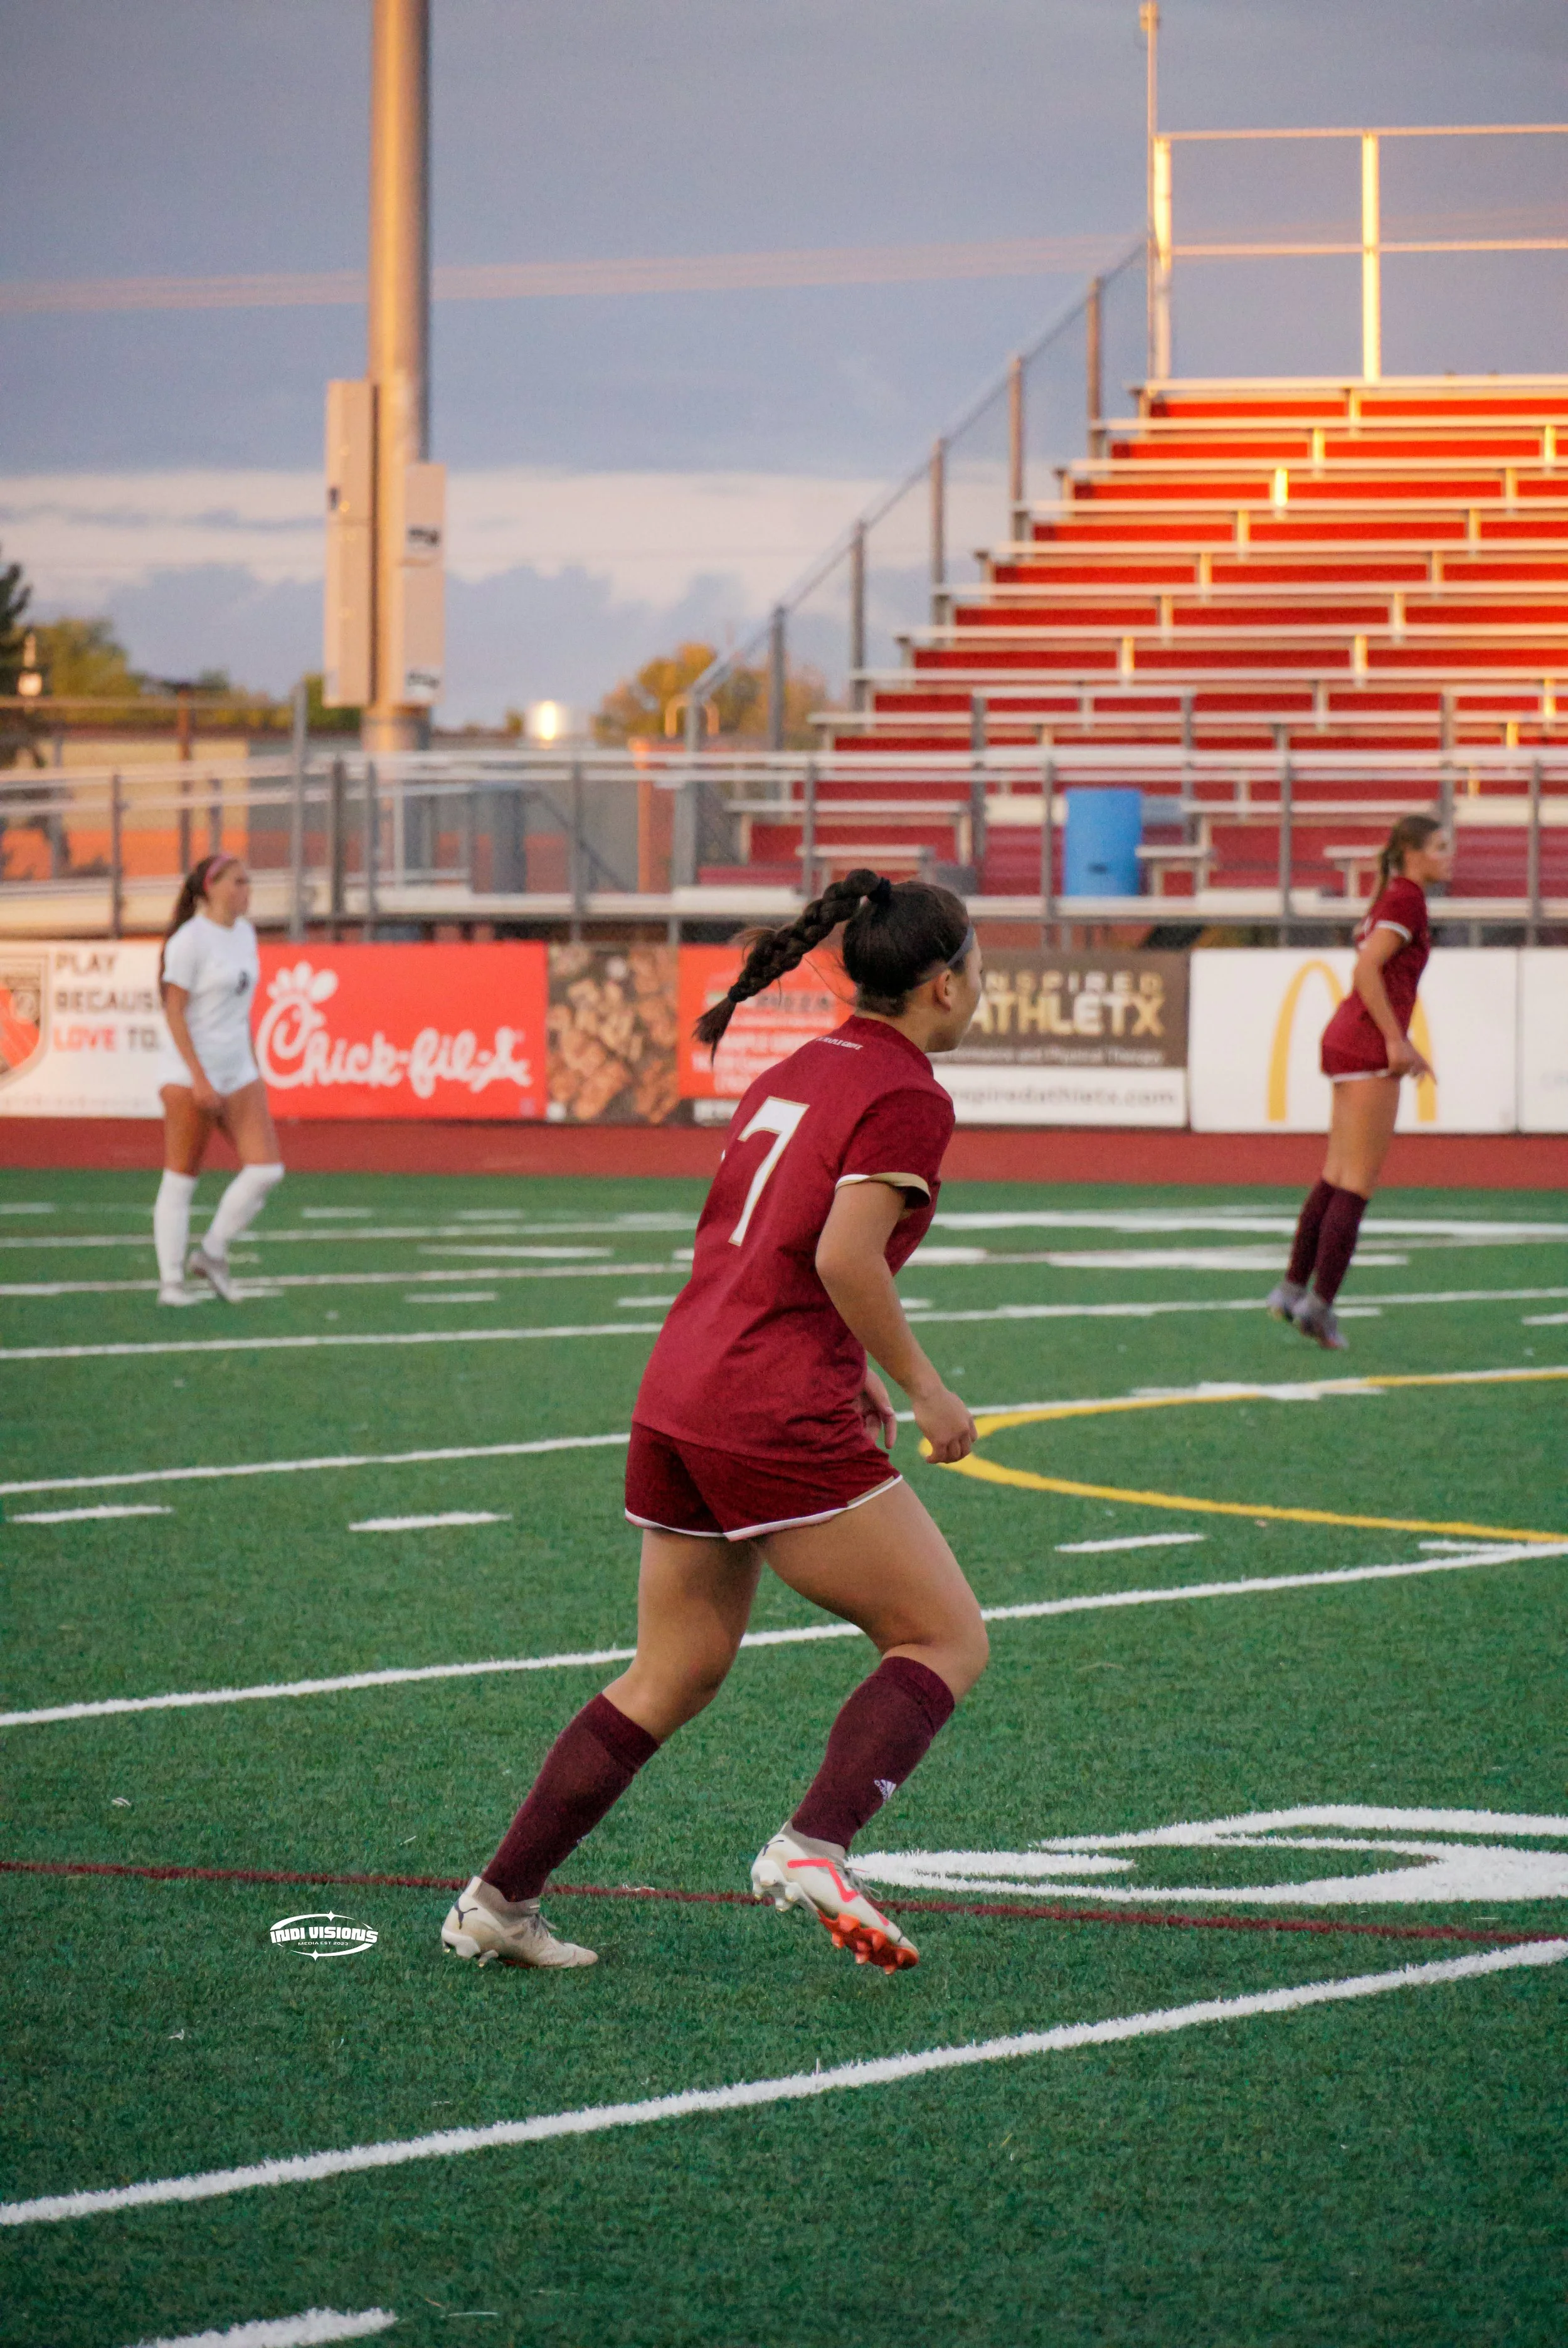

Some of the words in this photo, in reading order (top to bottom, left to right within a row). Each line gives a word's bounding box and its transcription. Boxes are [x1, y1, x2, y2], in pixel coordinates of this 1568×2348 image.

[55, 952, 118, 976] PLAY
[985, 970, 1163, 994] NSPIRED
[55, 990, 163, 1014] BECAUS
[972, 991, 1165, 1037] ATHLETX
[53, 1025, 117, 1052] LOVE
[255, 999, 532, 1099] Chick-fil-A
[728, 1096, 810, 1247] 7
